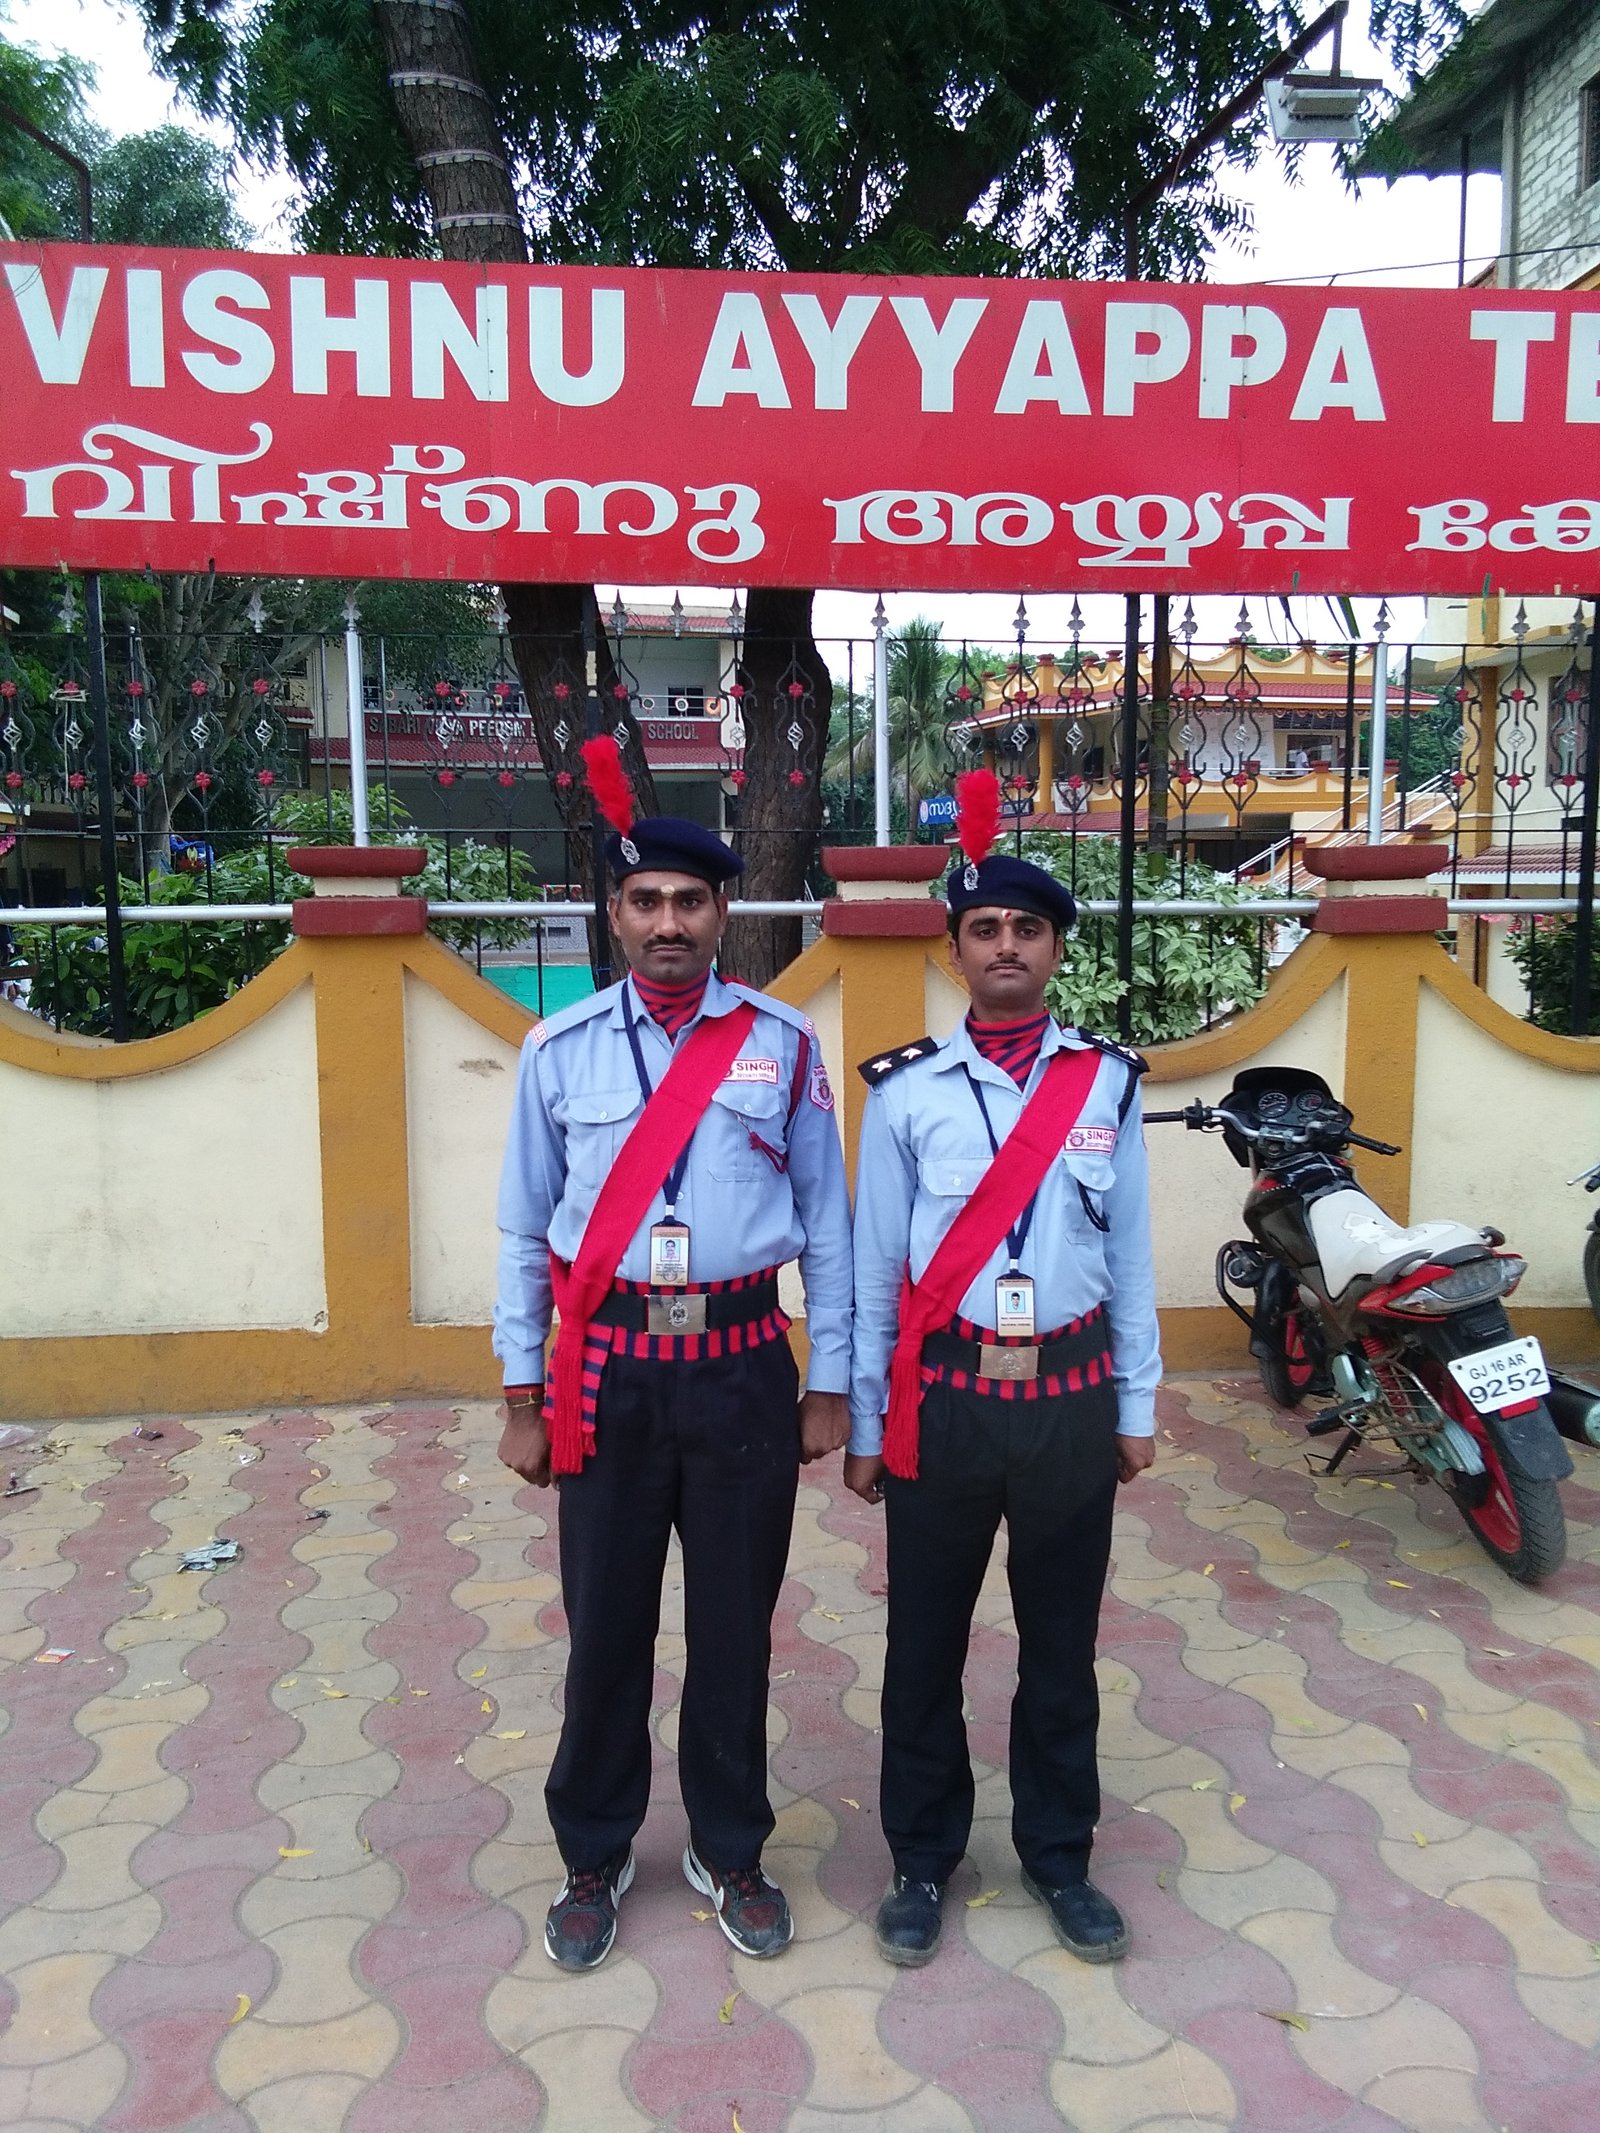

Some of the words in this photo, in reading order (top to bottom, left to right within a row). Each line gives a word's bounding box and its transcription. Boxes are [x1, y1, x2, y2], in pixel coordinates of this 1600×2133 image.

[3, 261, 625, 407] VISHNU
[691, 289, 1386, 421] AYYAPPA
[648, 723, 699, 740] SCHOOL
[736, 1062, 775, 1073] SINGH
[1086, 1130, 1115, 1142] SINGH
[1469, 1365, 1488, 1380] GJ
[1491, 1360, 1505, 1372] 16
[1508, 1353, 1527, 1368] AR
[1469, 1368, 1546, 1404] 9252
